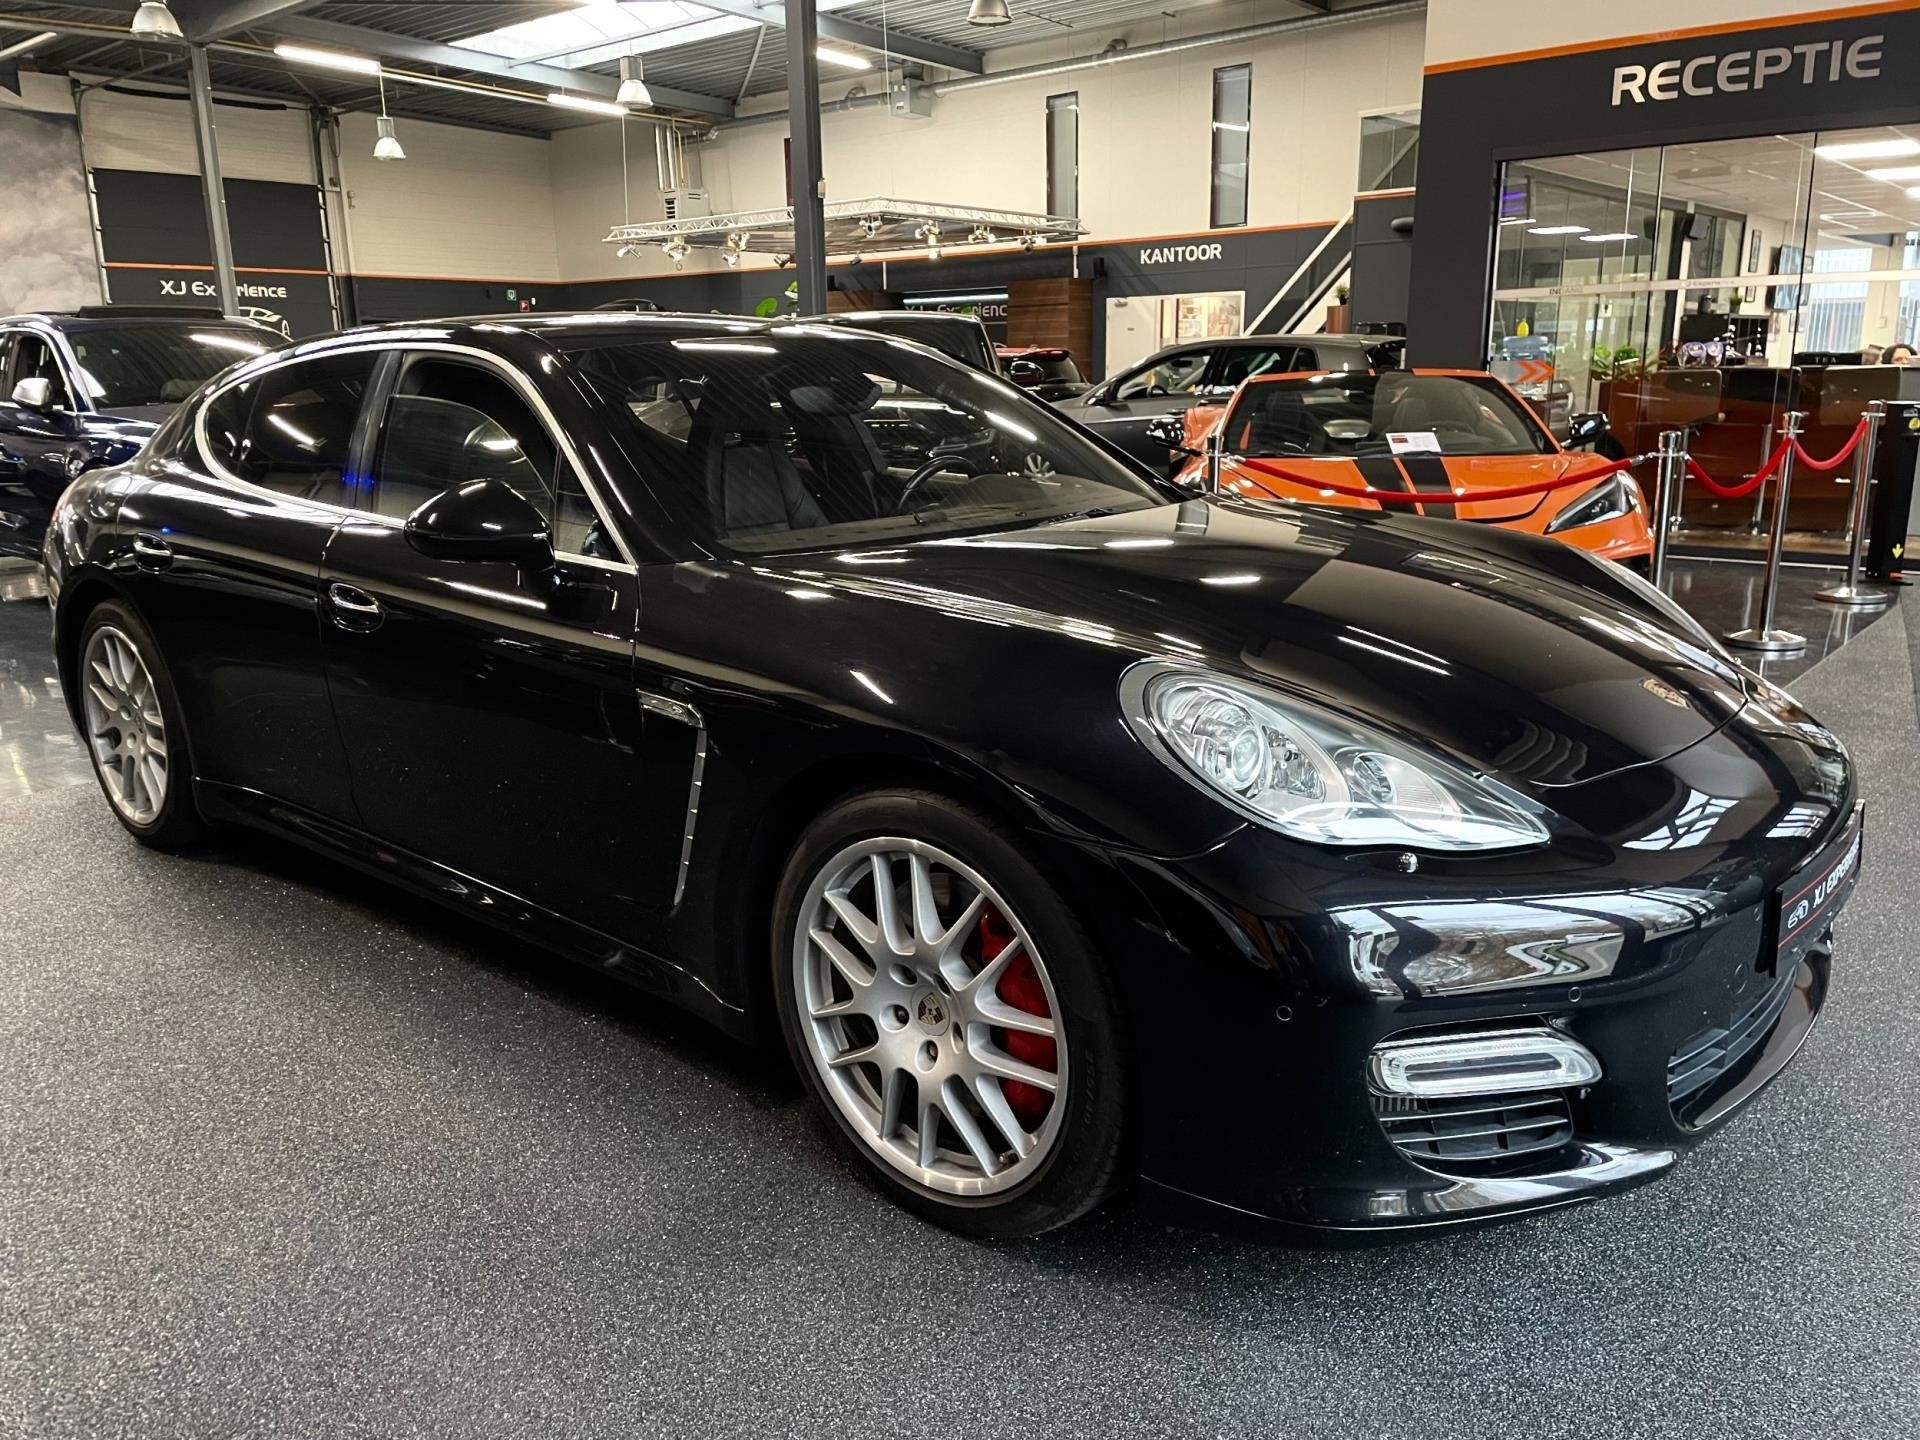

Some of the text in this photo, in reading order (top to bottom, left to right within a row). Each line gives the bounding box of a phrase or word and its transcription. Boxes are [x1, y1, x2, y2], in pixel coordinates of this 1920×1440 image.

[1611, 34, 1884, 106] RECEPTIE
[1140, 243, 1223, 265] KANTOOR
[160, 280, 288, 298] XJ Exrience
[1812, 880, 1826, 909] XJ
